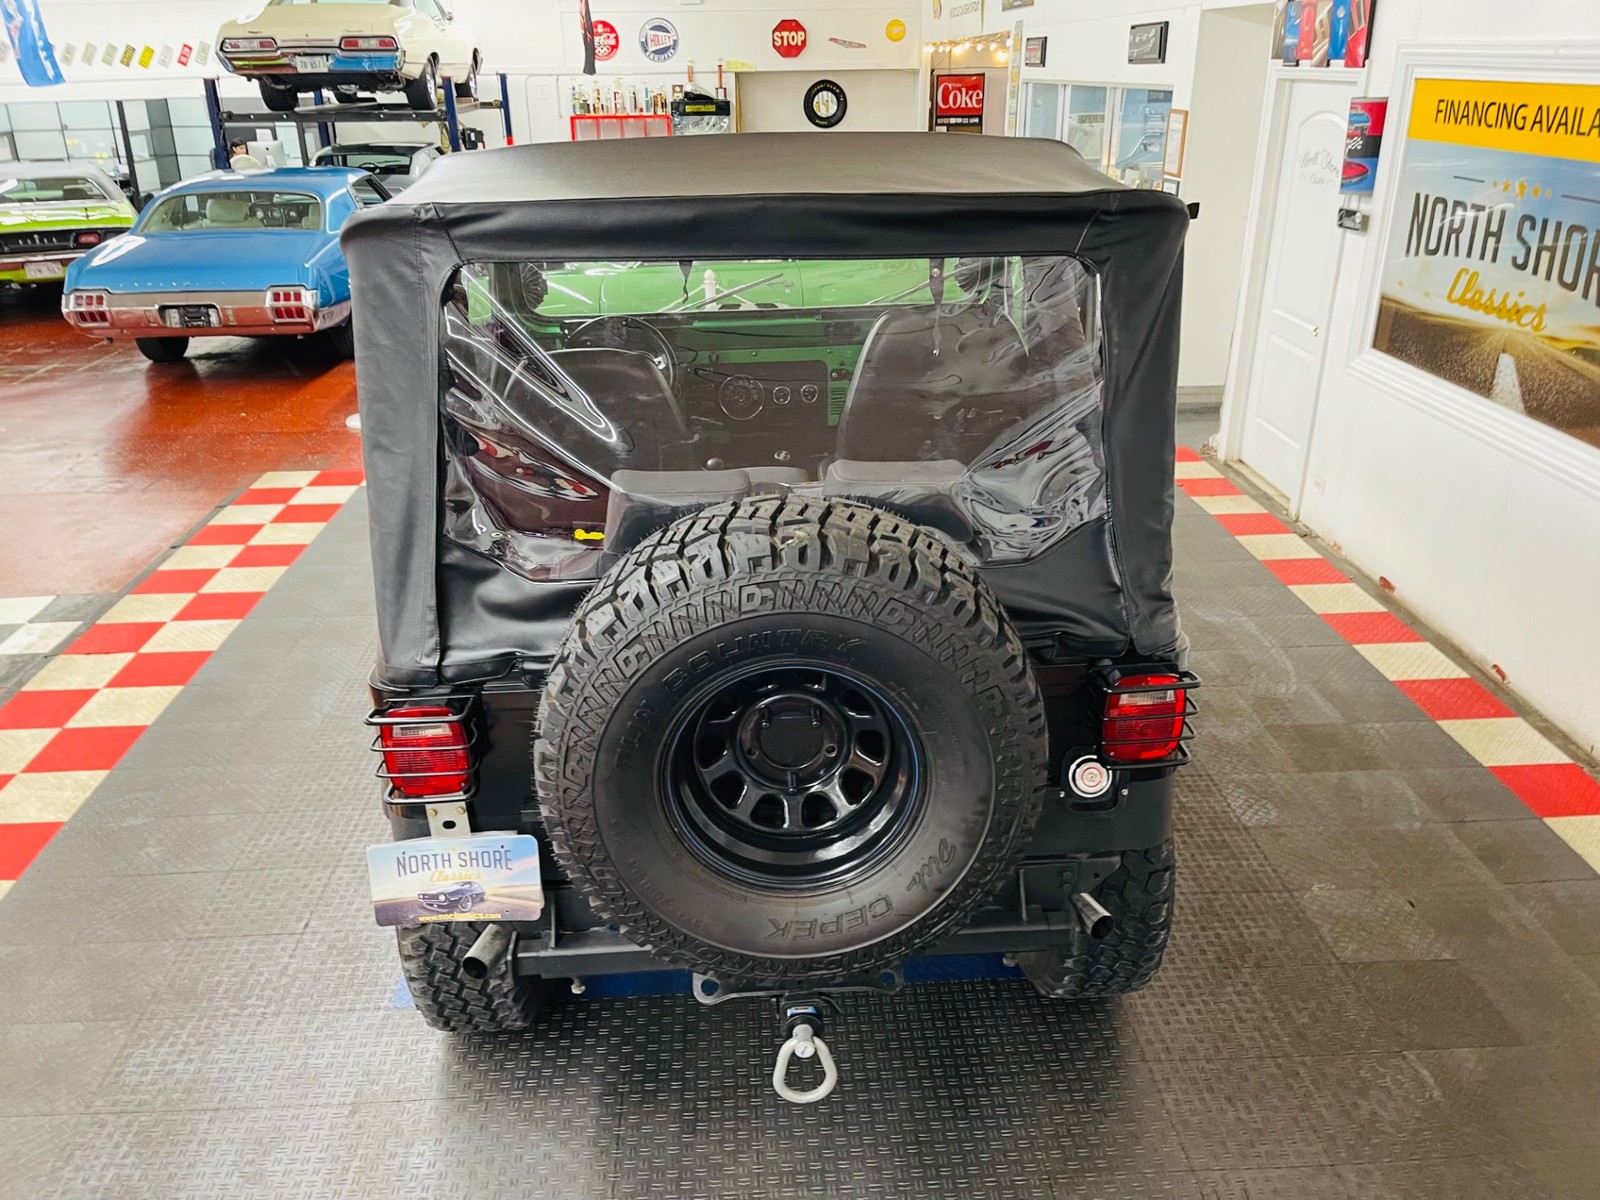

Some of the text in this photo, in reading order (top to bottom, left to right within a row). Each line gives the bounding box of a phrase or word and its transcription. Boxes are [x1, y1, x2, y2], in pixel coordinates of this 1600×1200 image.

[649, 33, 672, 49] HOLLEY
[773, 31, 805, 46] STOP
[937, 82, 983, 109] Coke
[1434, 99, 1529, 131] FINANCING
[1404, 192, 1506, 264] NORTH
[1446, 267, 1547, 333] Classics
[661, 628, 868, 693] COUNTRY
[396, 849, 513, 877] NORTH SHORE
[429, 870, 482, 883] Classics
[764, 837, 957, 941] Dick CEPEK
